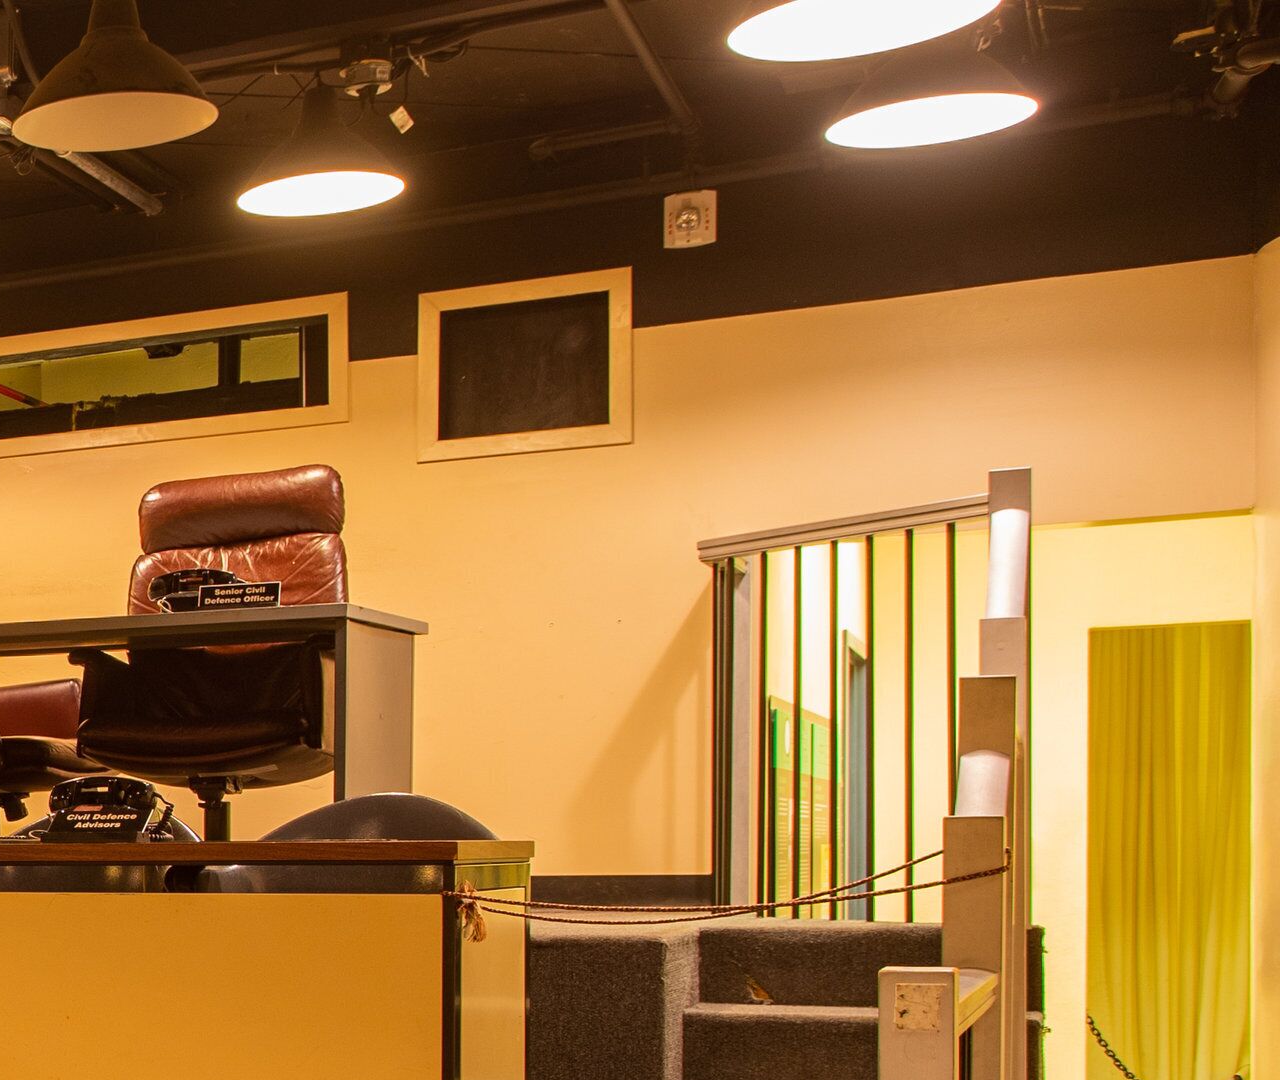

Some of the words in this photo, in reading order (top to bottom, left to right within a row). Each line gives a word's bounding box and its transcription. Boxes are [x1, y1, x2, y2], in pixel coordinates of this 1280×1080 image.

[214, 588, 244, 596] Senior
[245, 586, 266, 594] Civil
[204, 597, 242, 605] Defence
[243, 595, 275, 603] Officer
